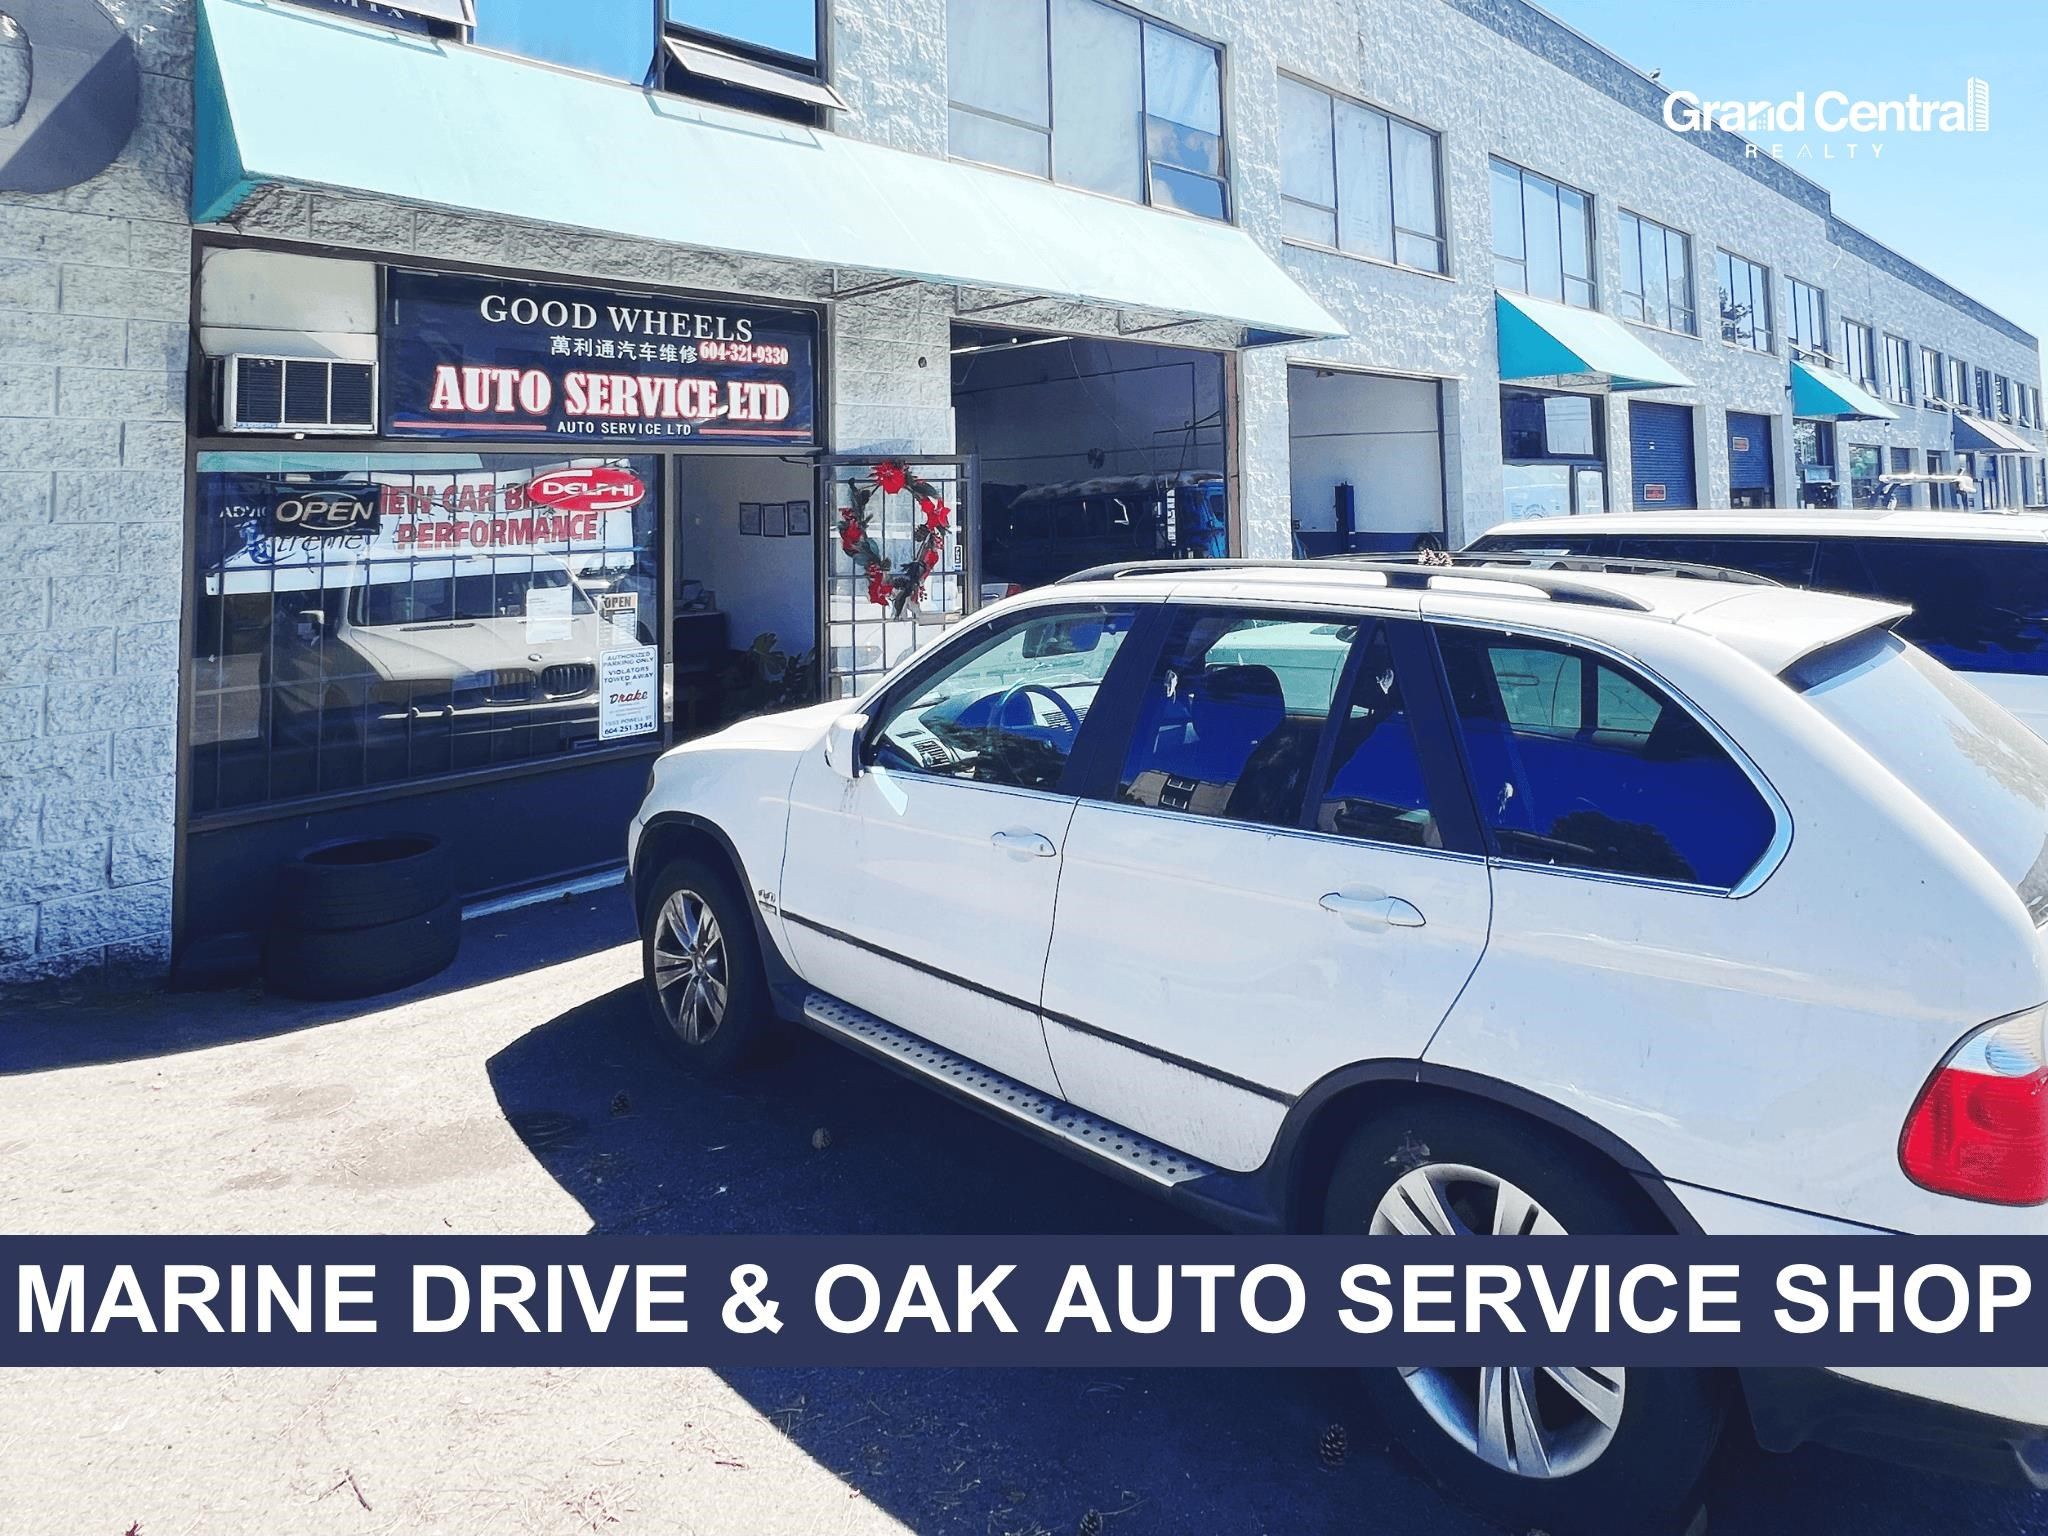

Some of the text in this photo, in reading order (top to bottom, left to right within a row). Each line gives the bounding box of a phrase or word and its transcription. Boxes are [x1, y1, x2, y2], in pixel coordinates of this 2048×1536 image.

[480, 294, 753, 343] GOOD WHEELS
[550, 335, 698, 364] 萬利通汽车维修
[699, 341, 789, 365] 604-321-9330
[430, 365, 790, 421] AUTO SERVICE LTD
[557, 421, 691, 436] AUTO SERVICE LTD
[543, 481, 634, 496] DELPHI
[443, 484, 495, 513] CAR
[275, 500, 374, 522] OPEN
[397, 512, 598, 550] PERFORMANCE
[604, 596, 632, 609] OPEN
[608, 652, 651, 662] AUTHORIZED
[635, 656, 654, 664] ONLY
[604, 672, 653, 683] TOWED AWAY
[608, 665, 649, 676] VIOLATORS
[609, 689, 648, 704] Drake
